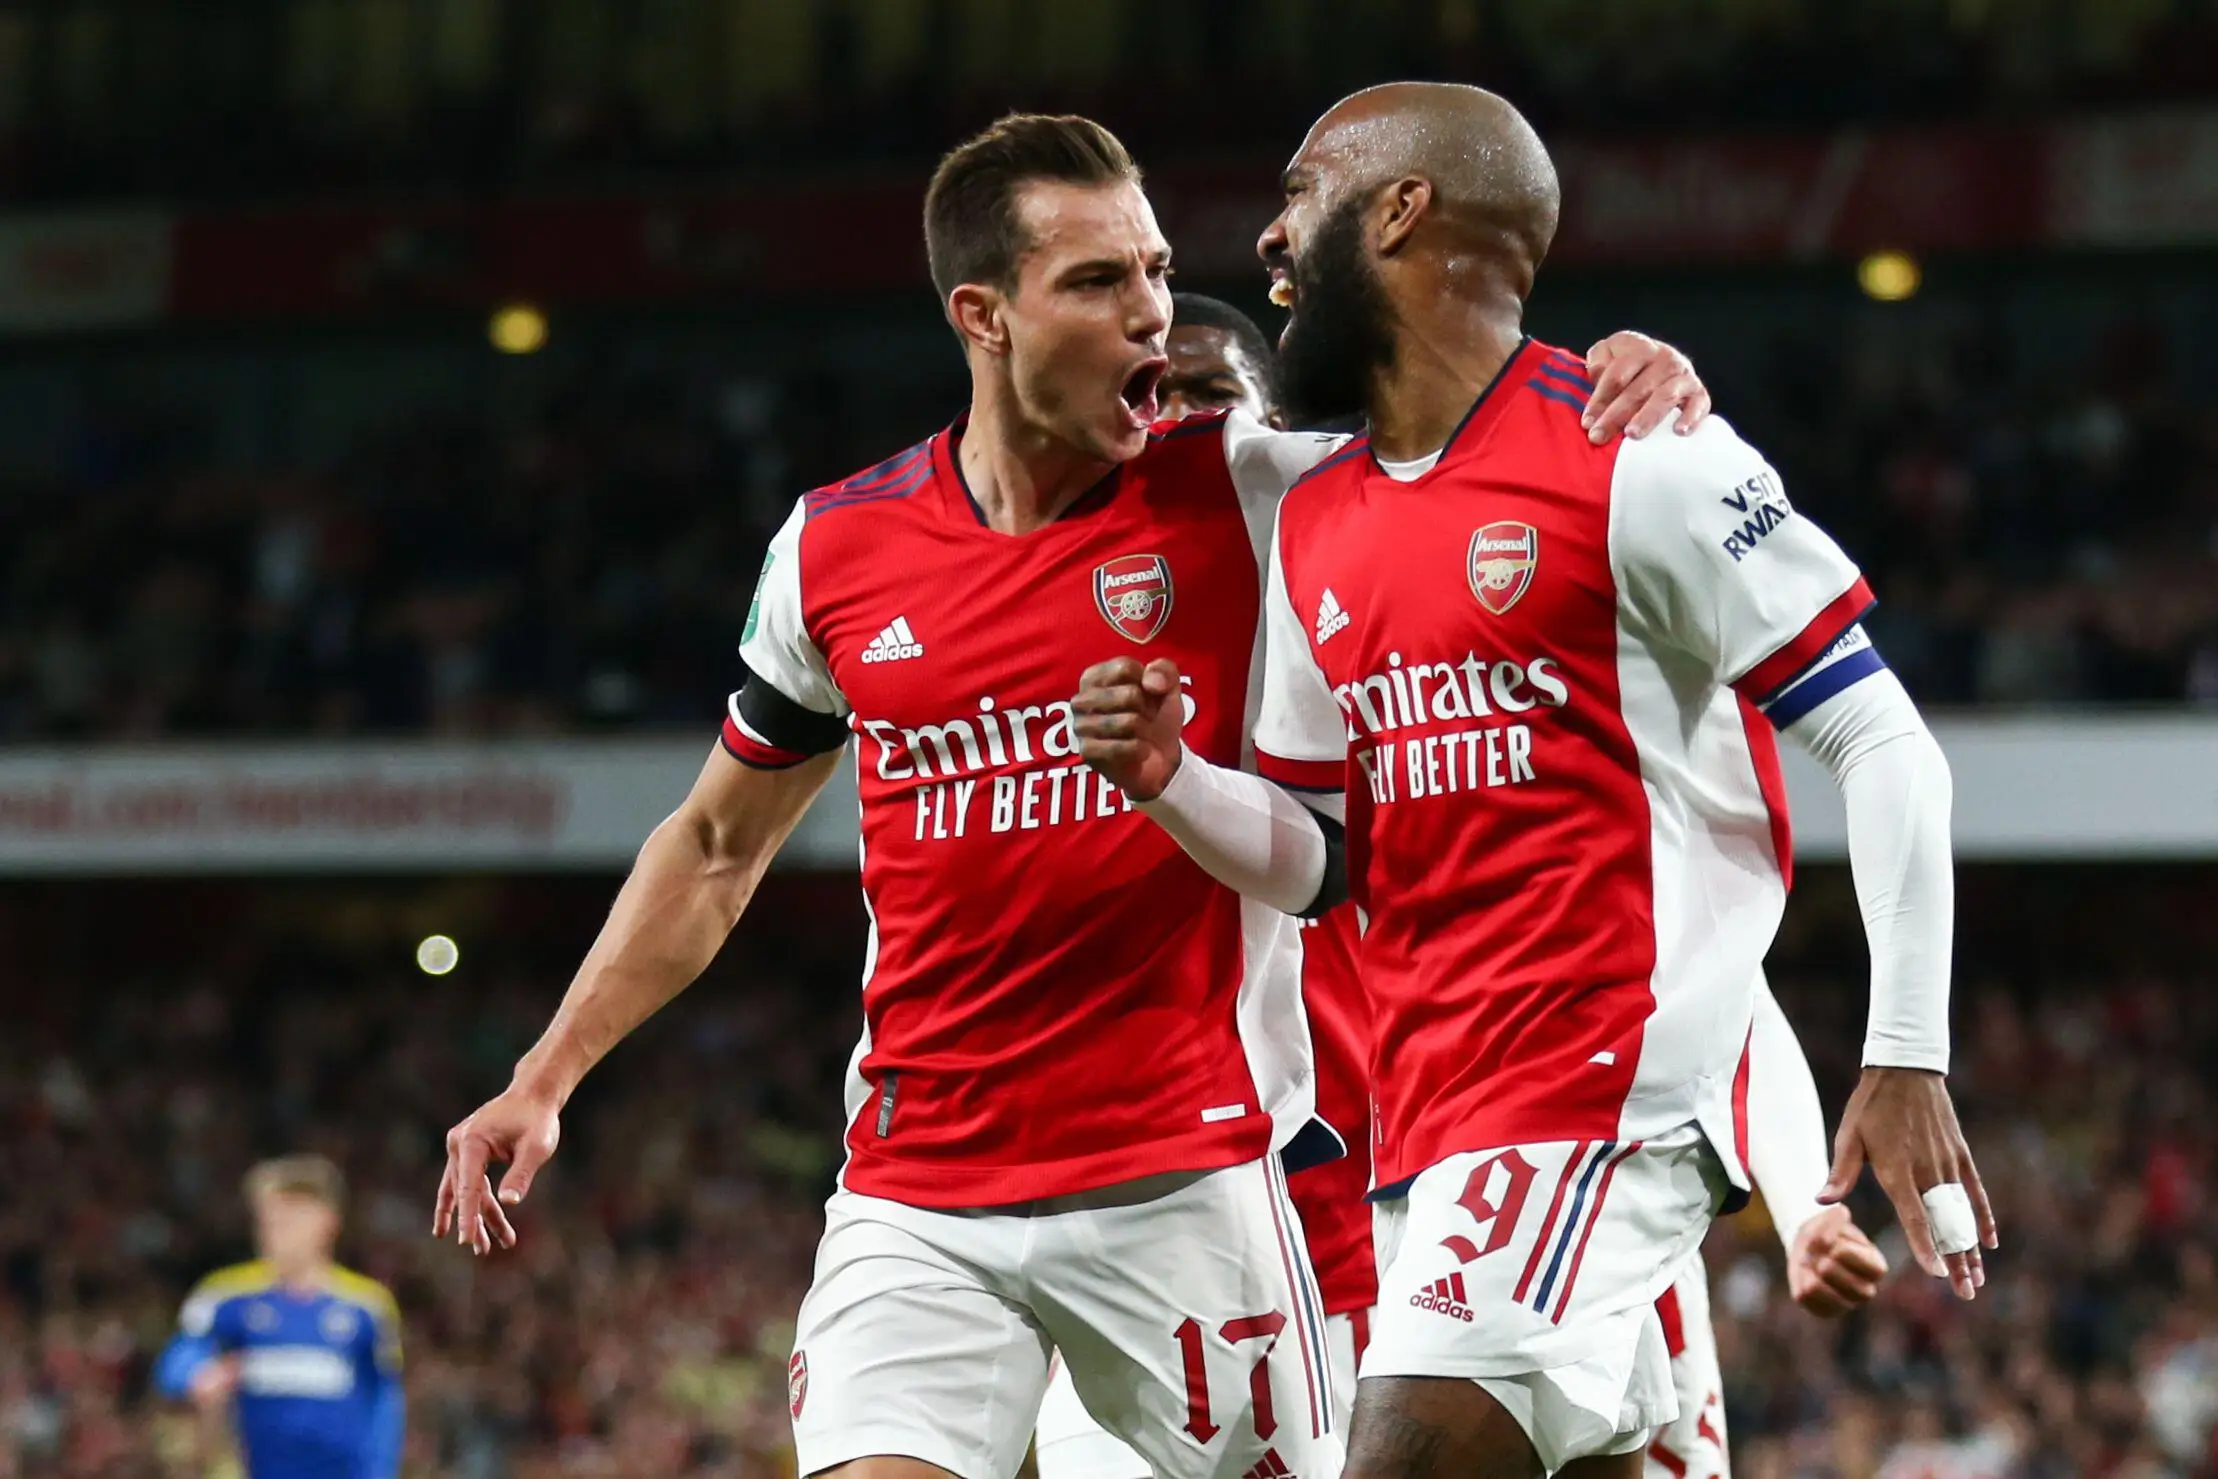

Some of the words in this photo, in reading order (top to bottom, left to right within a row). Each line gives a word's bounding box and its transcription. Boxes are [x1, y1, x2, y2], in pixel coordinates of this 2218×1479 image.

[1720, 472, 1777, 513] VISIT
[1477, 536, 1528, 552] Arsenal
[1104, 565, 1160, 589] Arsenal
[1316, 611, 1350, 646] adidas
[861, 643, 924, 664] adidas
[1333, 649, 1569, 742] mirates
[1356, 742, 1396, 804] FLY
[1406, 724, 1536, 800] BETTER
[914, 779, 976, 841] FLY
[1440, 1148, 1541, 1265] 9
[1409, 1294, 1475, 1323] adidas
[1173, 1309, 1287, 1445] 17
